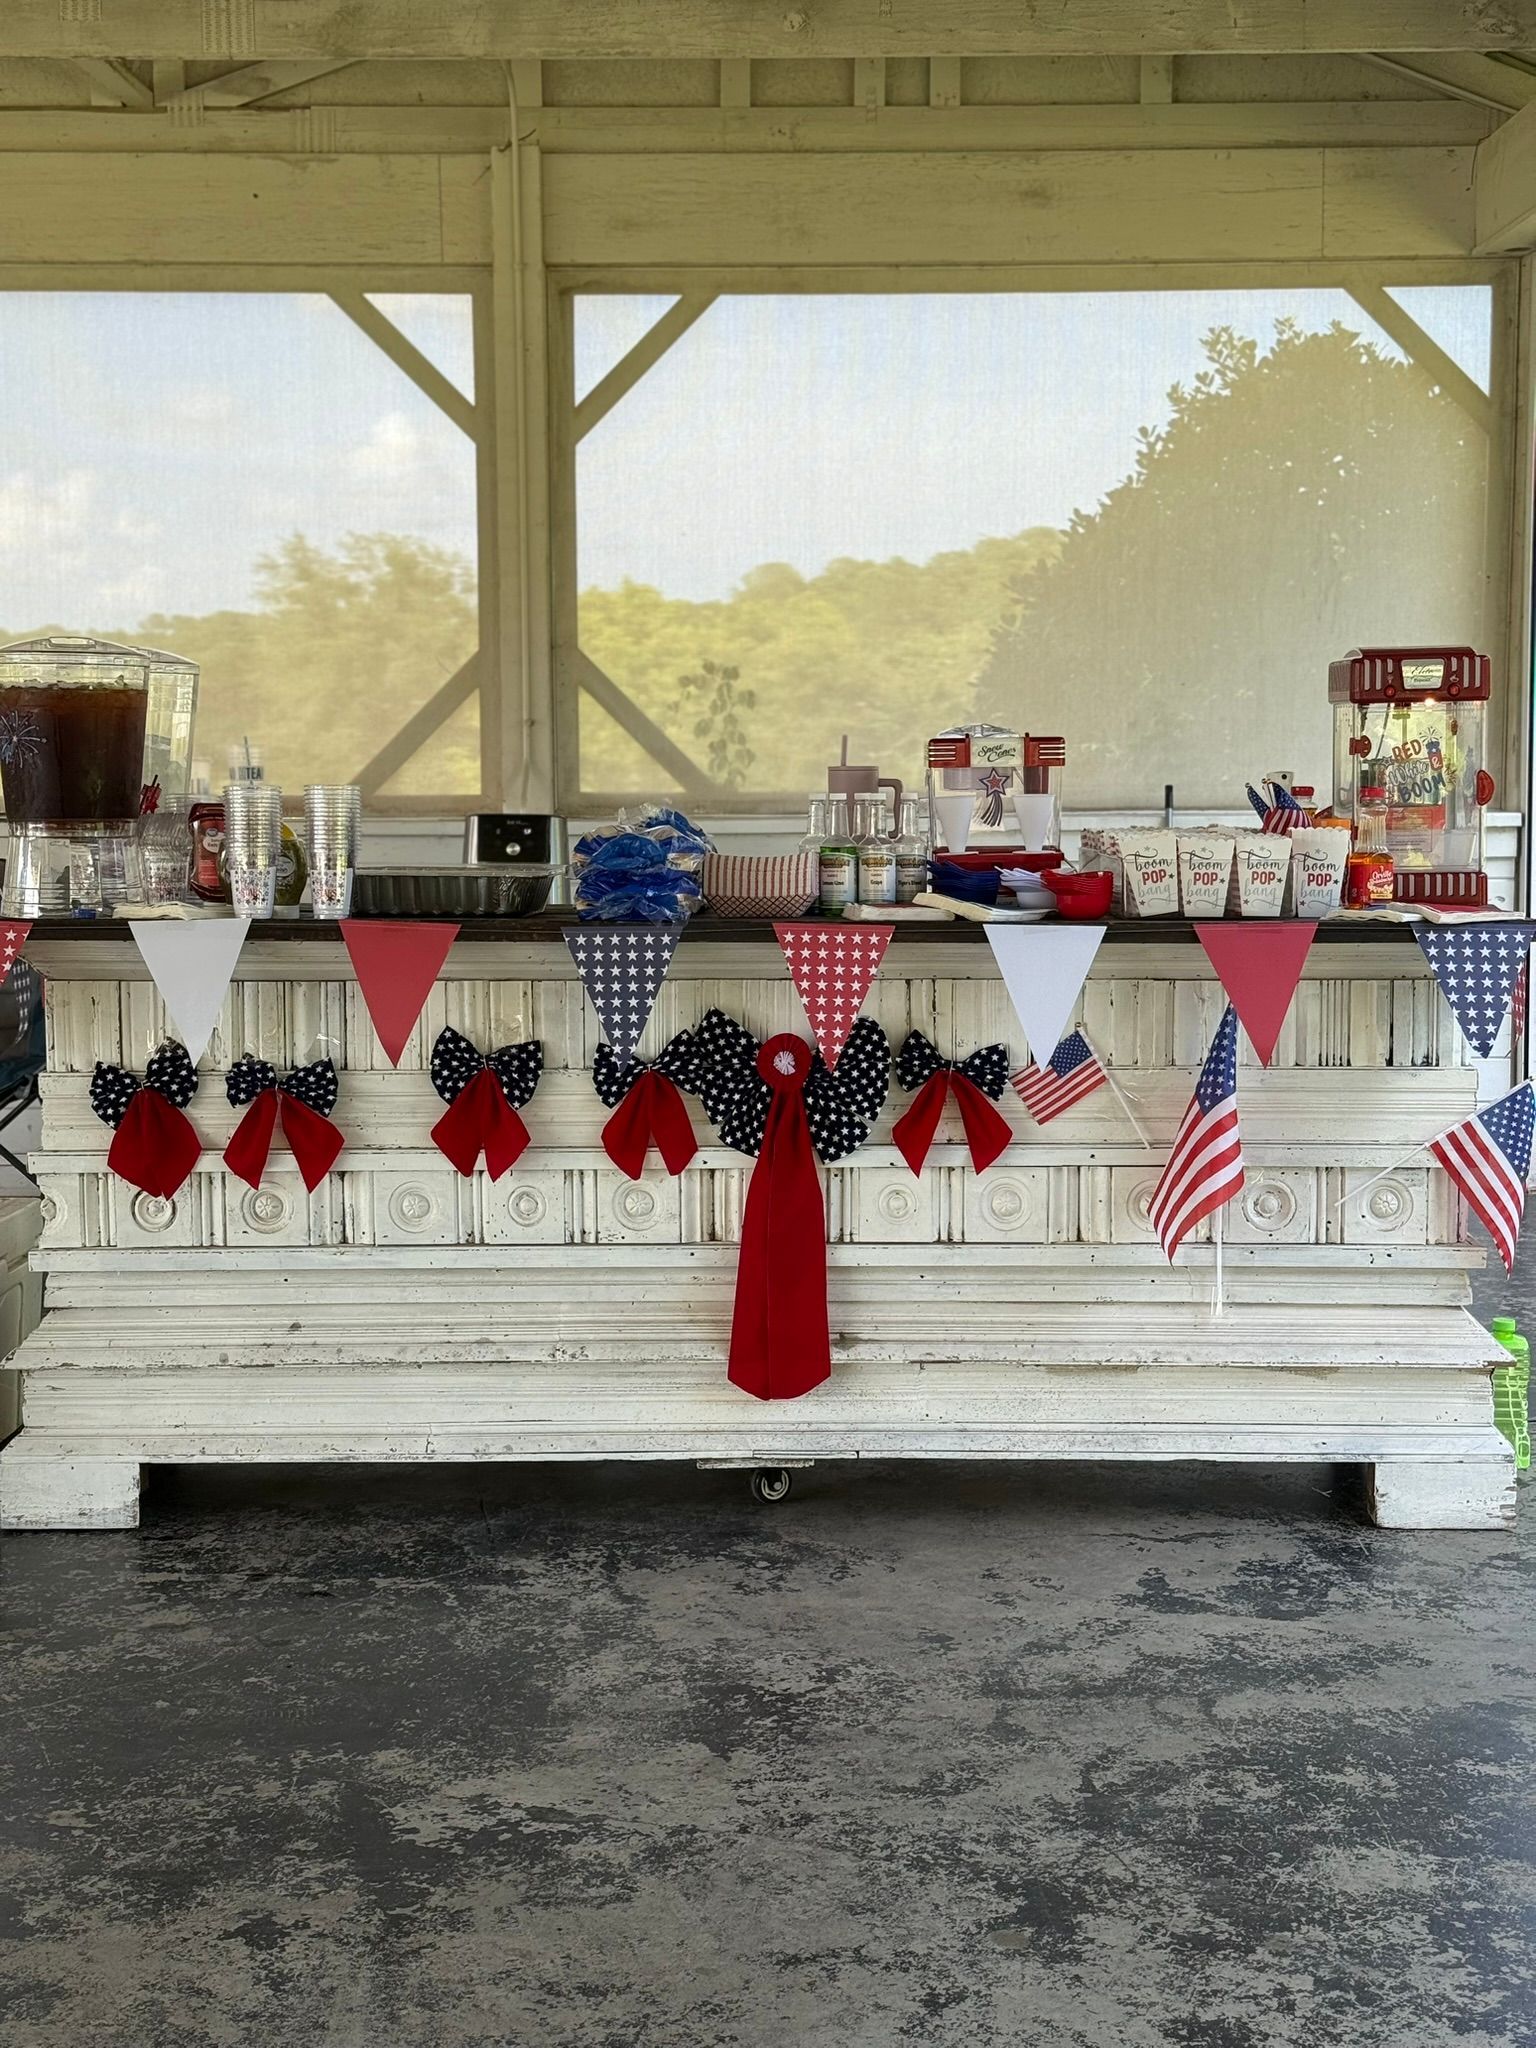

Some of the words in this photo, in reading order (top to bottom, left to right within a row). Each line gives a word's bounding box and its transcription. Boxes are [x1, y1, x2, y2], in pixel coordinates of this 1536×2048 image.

[978, 743, 1004, 757] Snow
[987, 747, 1016, 762] Cones
[1392, 739, 1422, 761] RED
[1388, 760, 1430, 785] White
[1400, 772, 1446, 803] BOOM
[1124, 849, 1173, 871] boom
[1180, 850, 1227, 871] boom
[1238, 849, 1285, 870] boom
[1292, 852, 1340, 872] boom
[1142, 869, 1167, 885] POP
[1193, 872, 1218, 885] POP
[1251, 871, 1276, 885] POP
[1307, 873, 1332, 887] POP
[1137, 880, 1173, 903] bang
[1187, 880, 1224, 907] bang
[1245, 880, 1280, 907] bang
[1300, 880, 1340, 907] bang
